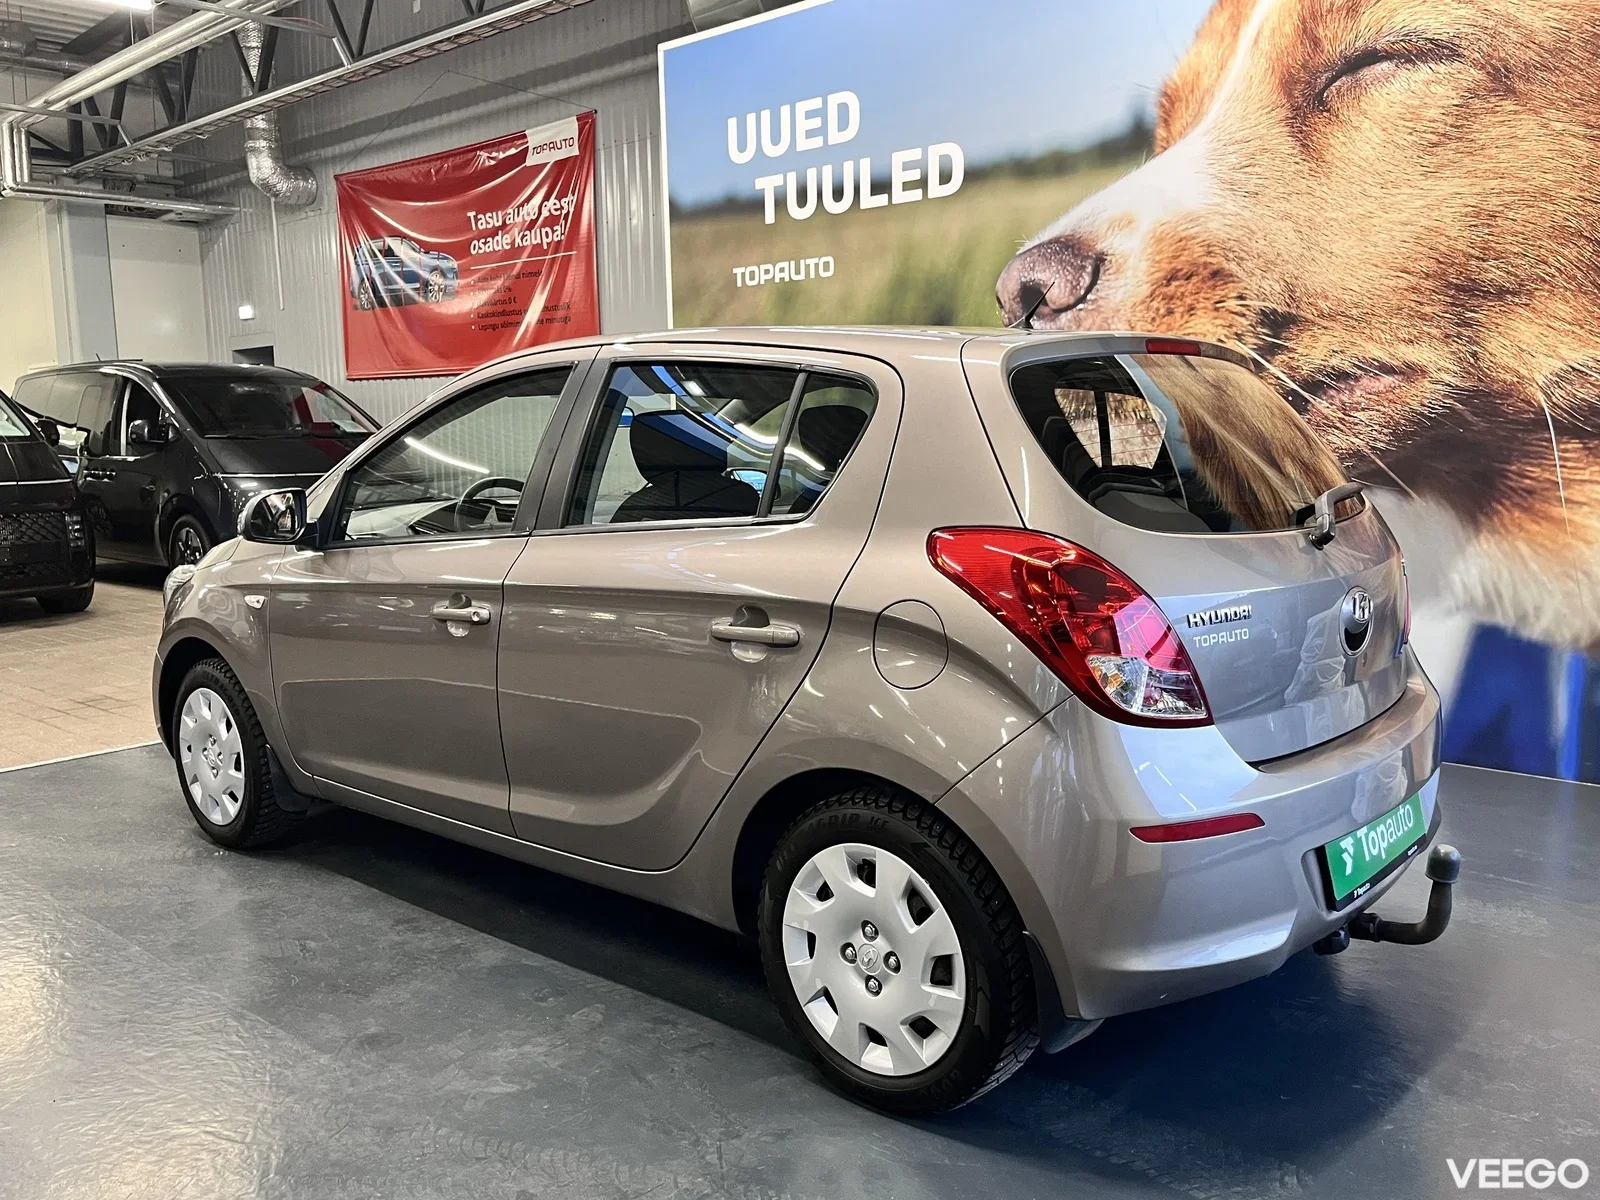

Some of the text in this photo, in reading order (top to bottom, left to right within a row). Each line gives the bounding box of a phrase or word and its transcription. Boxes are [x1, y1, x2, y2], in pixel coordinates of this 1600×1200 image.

[727, 90, 860, 165] UUED
[531, 136, 575, 156] TOPAUTO
[754, 142, 965, 225] TUULED
[467, 194, 574, 231] Tasu auto eest
[470, 220, 565, 255] osade kaupa!
[732, 255, 835, 288] TOPAUTO
[1187, 604, 1253, 629] HYUNDAI
[1193, 628, 1249, 648] TOPAUTO
[1357, 804, 1414, 861] Topauto
